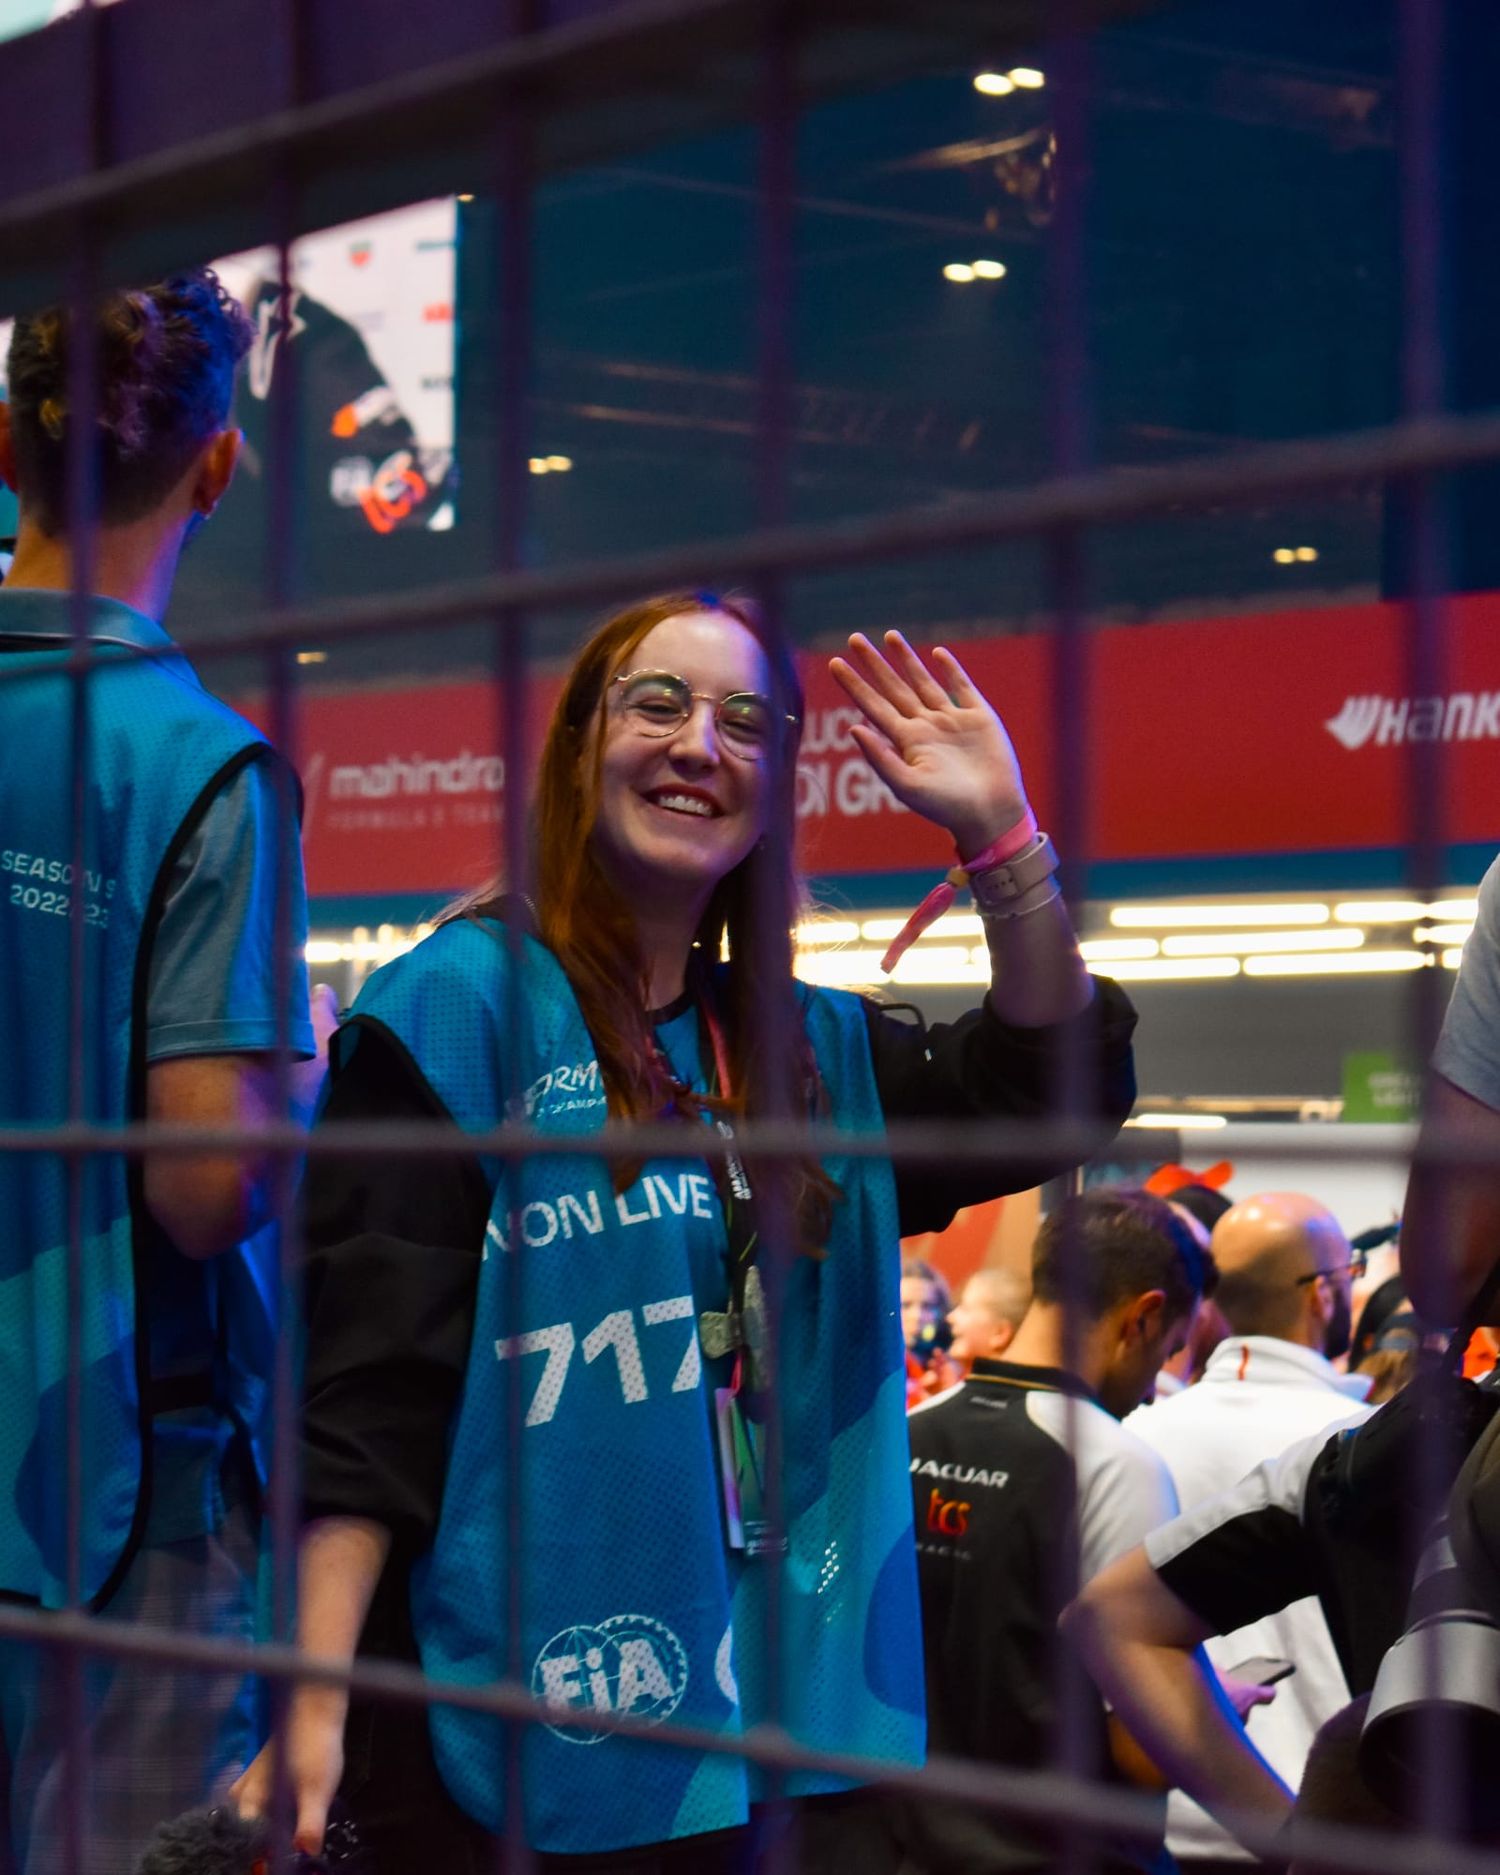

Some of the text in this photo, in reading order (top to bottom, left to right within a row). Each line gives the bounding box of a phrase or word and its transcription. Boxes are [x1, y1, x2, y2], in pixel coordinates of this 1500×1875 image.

[1, 850, 102, 893] SEASON
[616, 1174, 713, 1226] LIVE
[495, 1295, 700, 1428] 717
